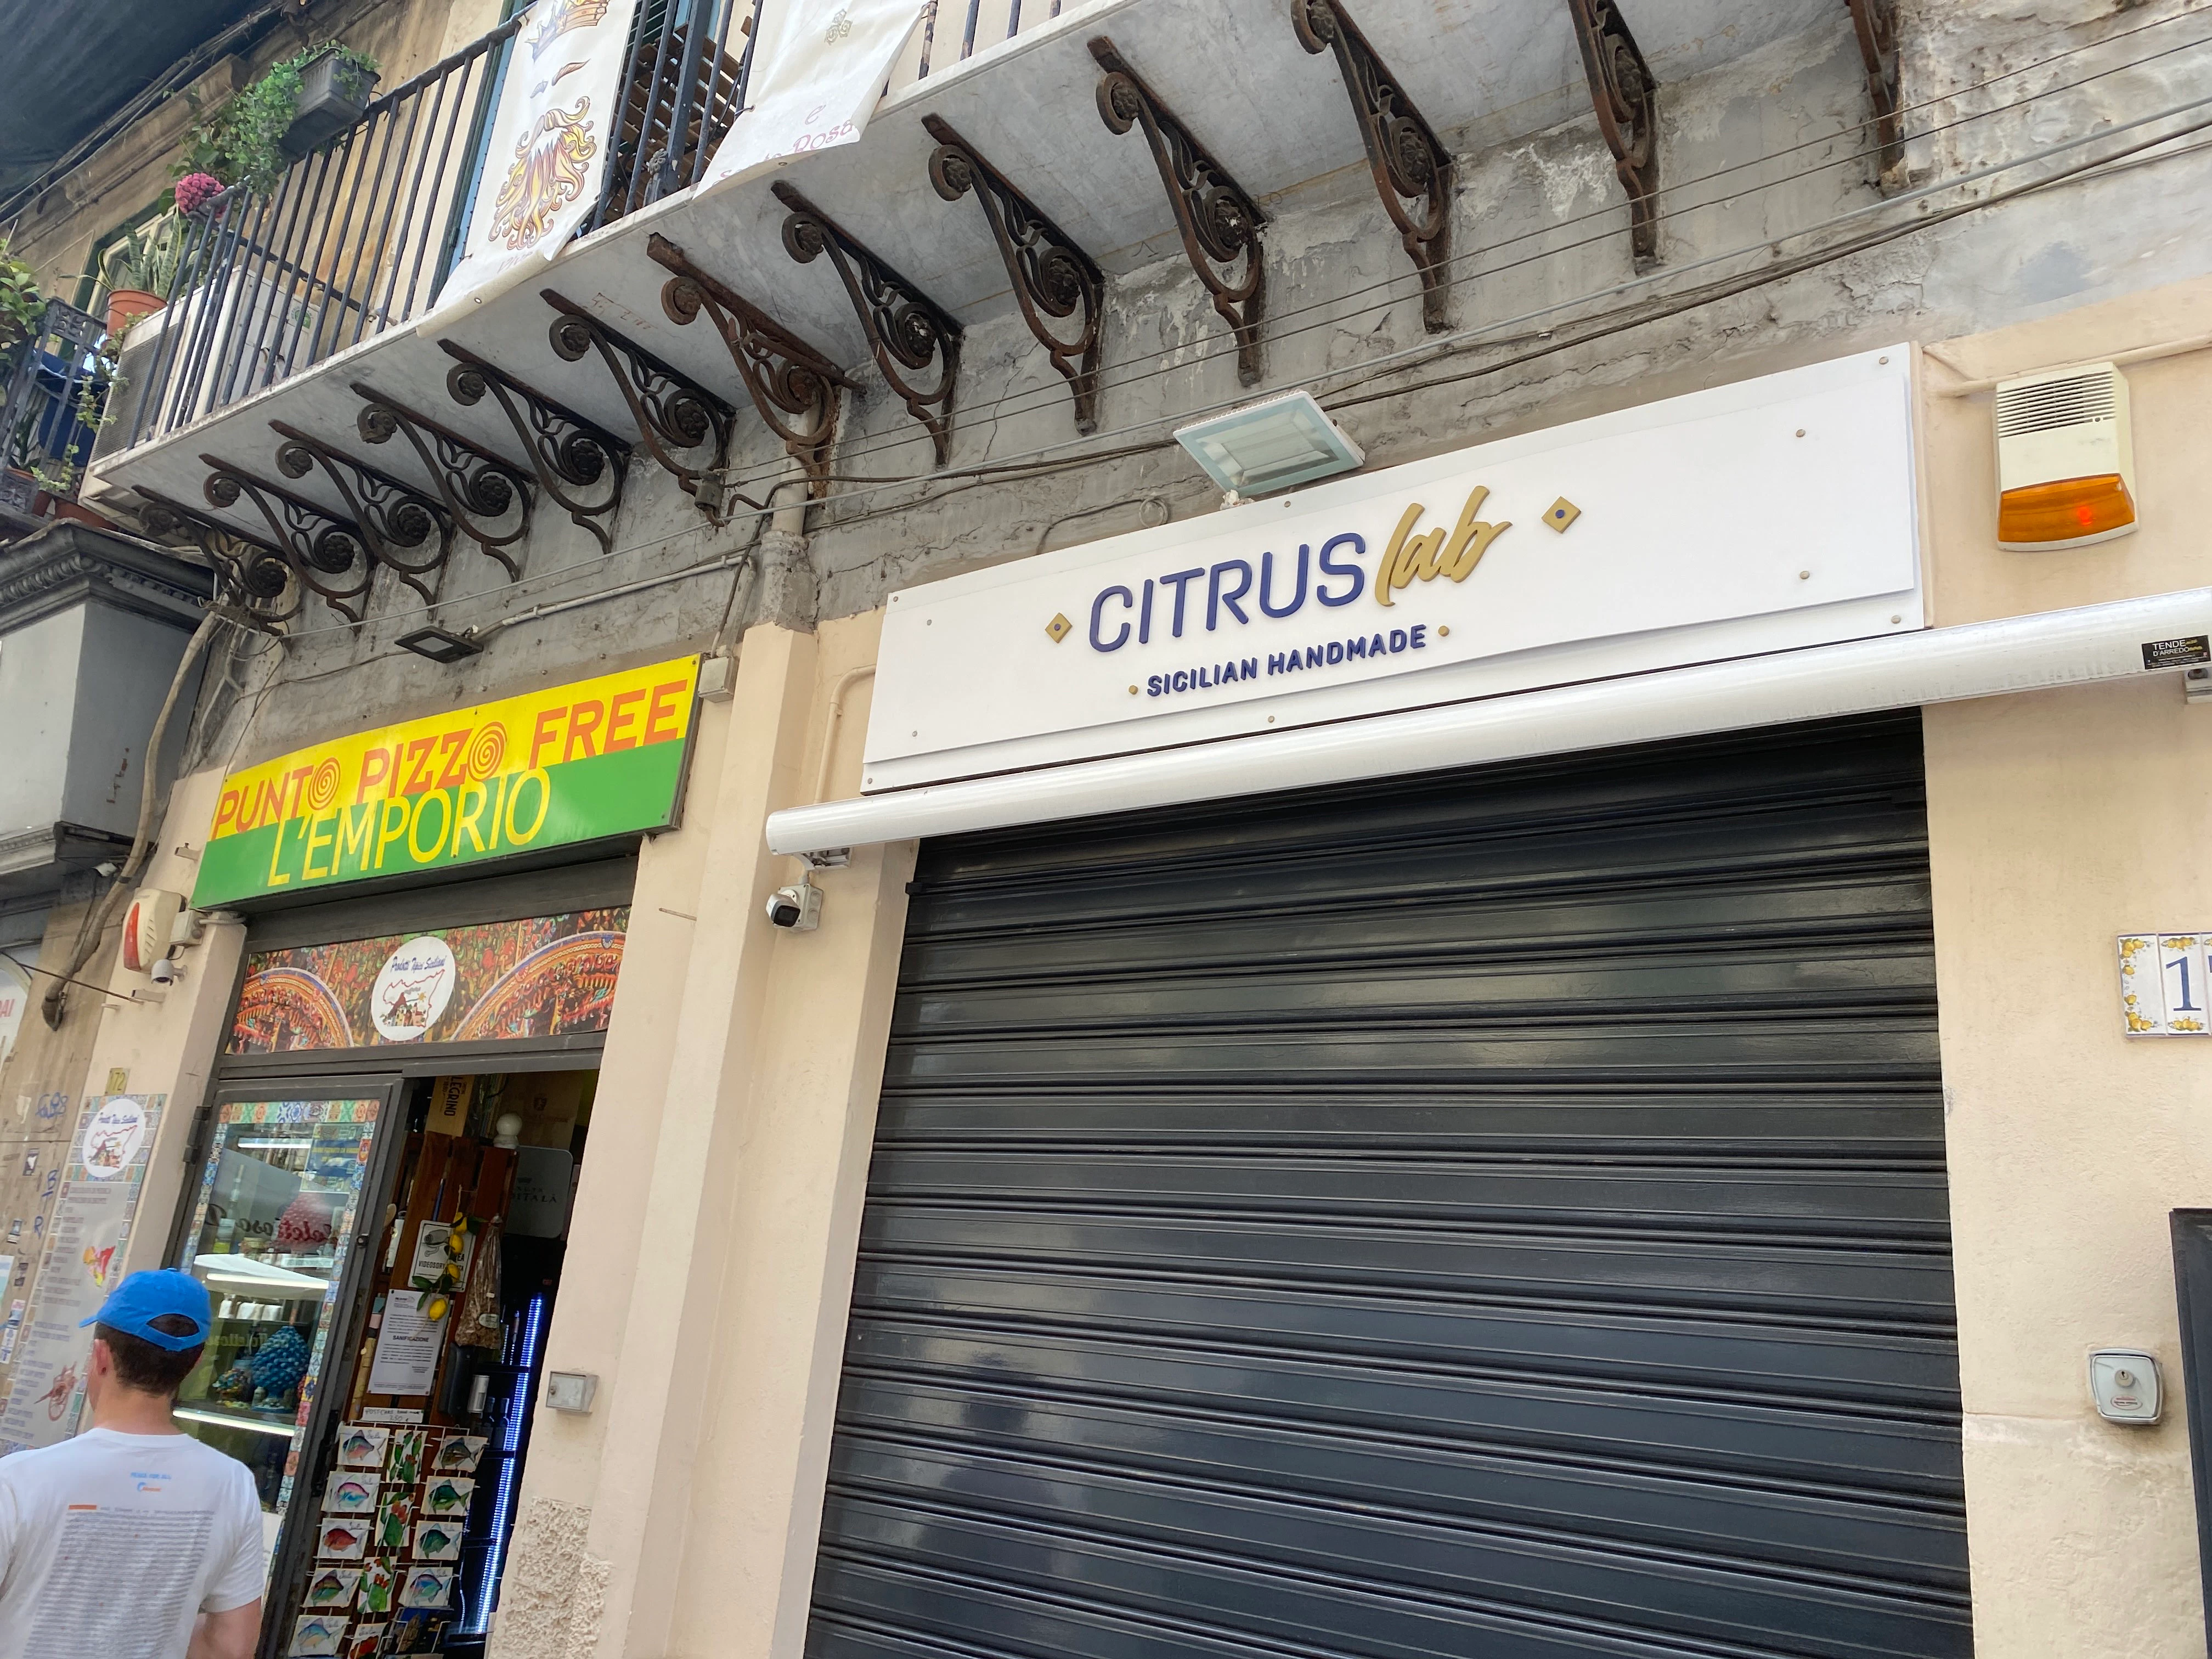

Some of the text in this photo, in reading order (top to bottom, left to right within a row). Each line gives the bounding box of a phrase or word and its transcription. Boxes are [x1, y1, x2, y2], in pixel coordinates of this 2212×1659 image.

[1089, 485, 1513, 653] CITRUS lab
[1147, 624, 1427, 697] SICILIAN HANDMADE
[2152, 640, 2186, 651] TENDE
[2153, 647, 2190, 657] D'ARREDO
[213, 679, 689, 840] PUNTO PIZZO FREE
[267, 767, 551, 887] L'EMPORIO
[2165, 956, 2212, 1012] 1
